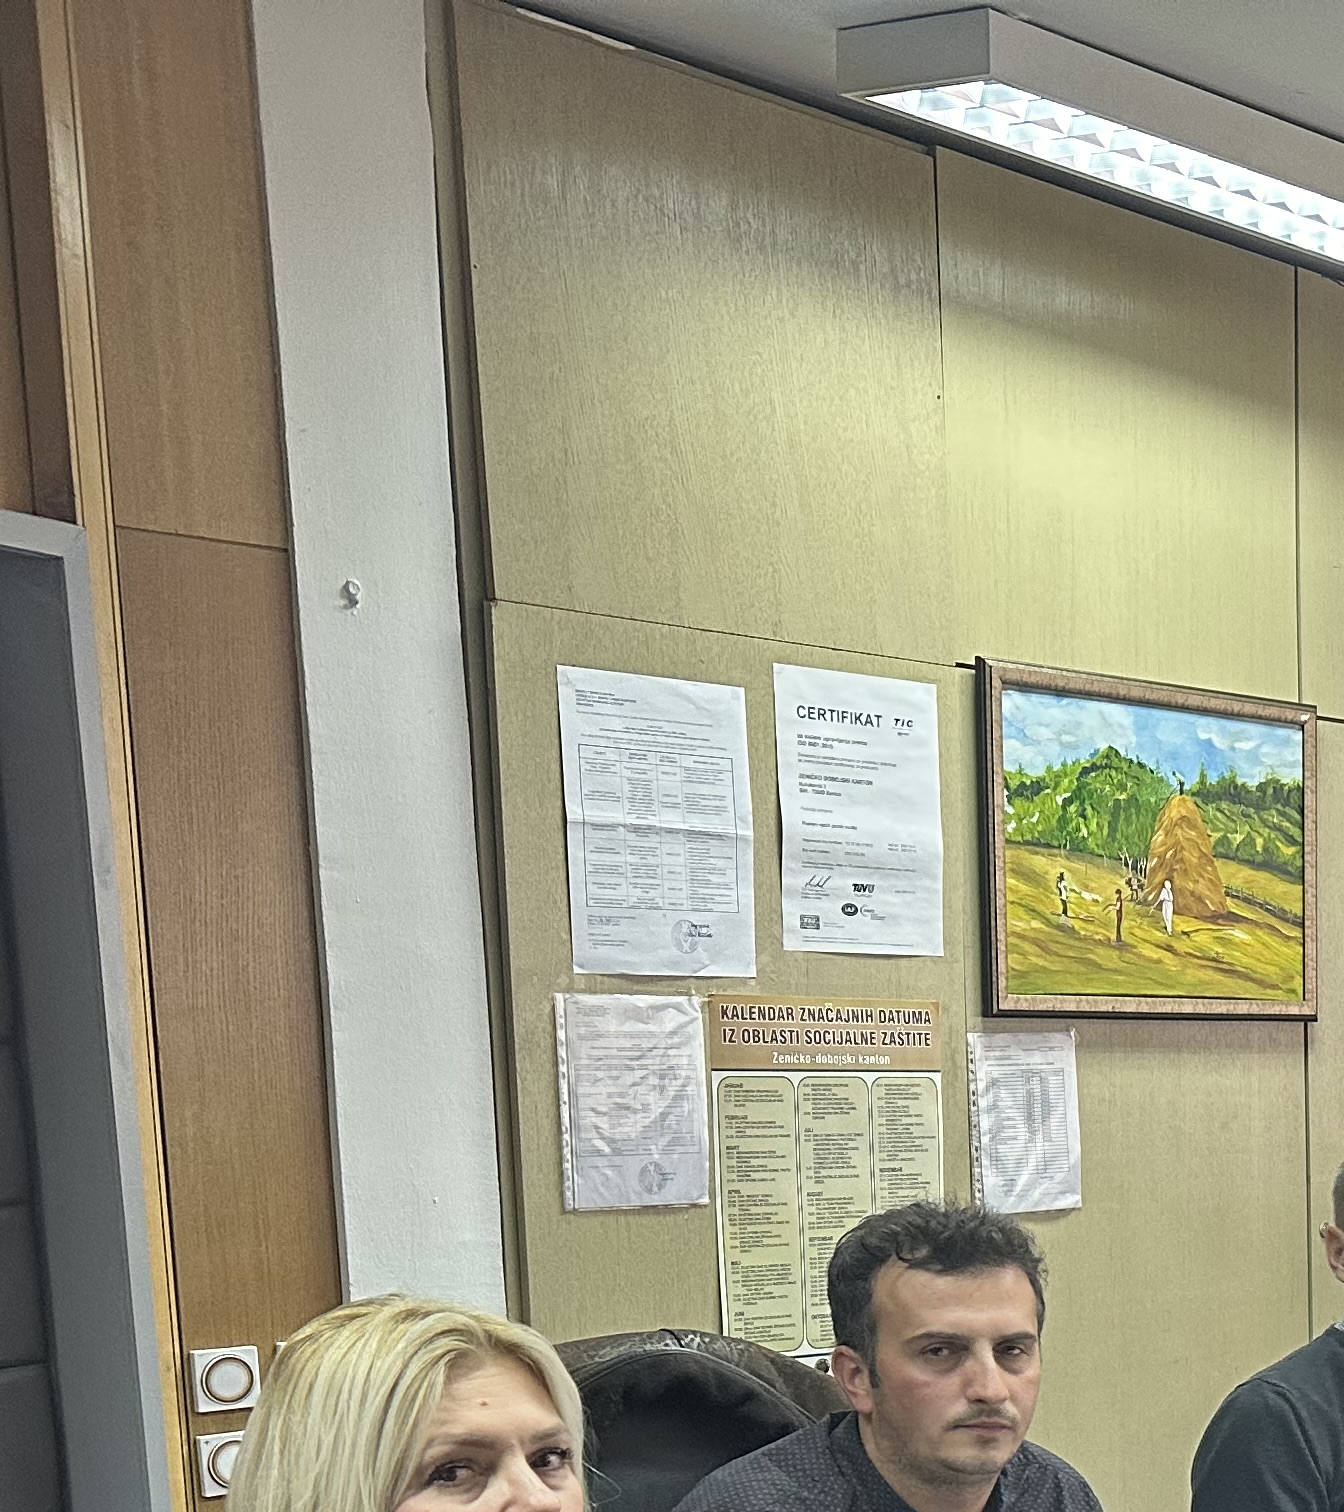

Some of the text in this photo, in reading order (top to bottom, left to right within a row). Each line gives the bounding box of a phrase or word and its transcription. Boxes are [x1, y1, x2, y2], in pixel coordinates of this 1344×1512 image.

[796, 705, 914, 728] CERTIFIKAT TIC
[720, 1003, 932, 1025] KALENDAR ZNAČAJNIH DATUMA
[721, 1027, 931, 1047] IZ OBLASTI SOCIJALNE ZAŠTITE
[858, 1054, 891, 1065] kanton
